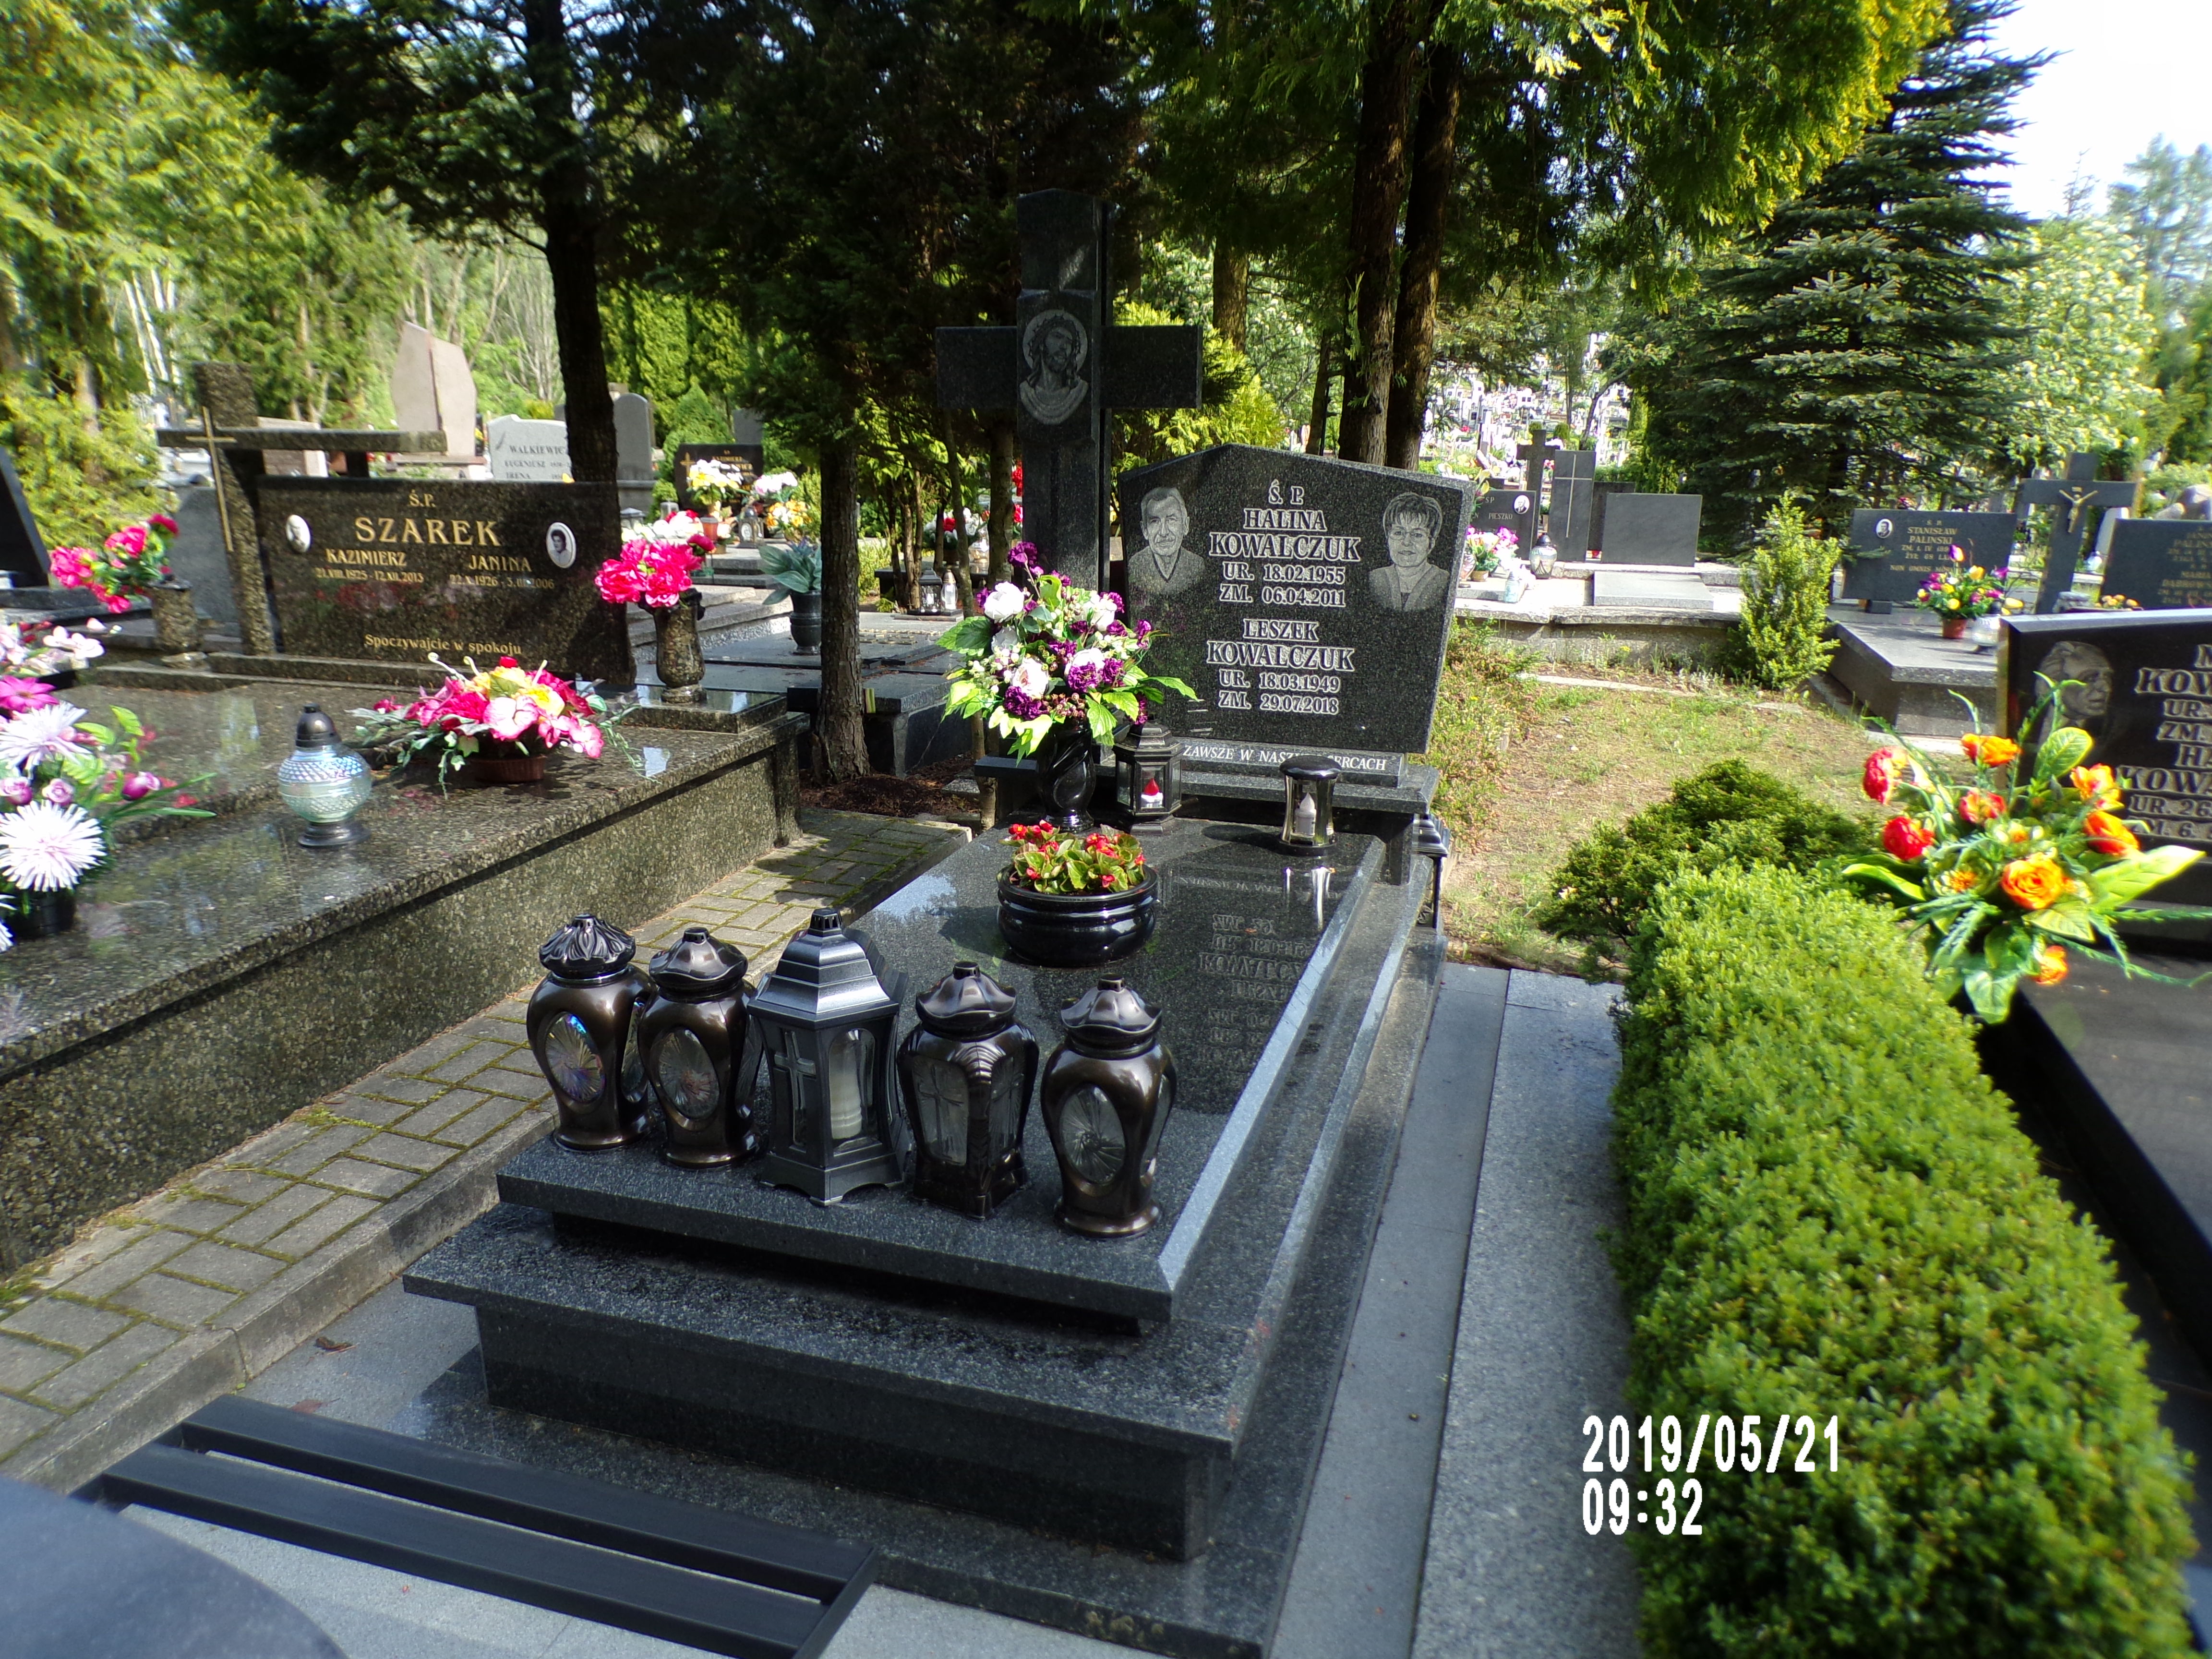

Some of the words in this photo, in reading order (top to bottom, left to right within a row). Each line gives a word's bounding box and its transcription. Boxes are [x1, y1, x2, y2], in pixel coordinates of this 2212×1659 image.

[509, 445, 565, 455] WALKIEWIC
[1243, 508, 1327, 531] HALINA
[355, 517, 502, 546] SZAREK
[325, 549, 408, 567] KAZIMIERZ
[1209, 532, 1361, 562] KOWALCZUK
[469, 554, 532, 572] JANINA
[1223, 562, 1254, 580] UR.
[1263, 564, 1345, 584] 18.02.1955
[1220, 583, 1253, 602] ZM.
[1262, 586, 1346, 607] 06.04.2011
[1243, 618, 1319, 642] LESZEK
[365, 634, 450, 652] Spoczywajcie
[454, 640, 464, 651] w
[469, 641, 522, 656] spokoju
[1206, 640, 1355, 672] KOWALCZUK
[1219, 669, 1250, 688] UR.
[1260, 672, 1341, 693] 18.03.1949
[1219, 690, 1251, 709] ZM.
[1260, 694, 1339, 715] 29.07.2018
[1183, 745, 1234, 759] ZAWSZE
[1240, 749, 1254, 761] W
